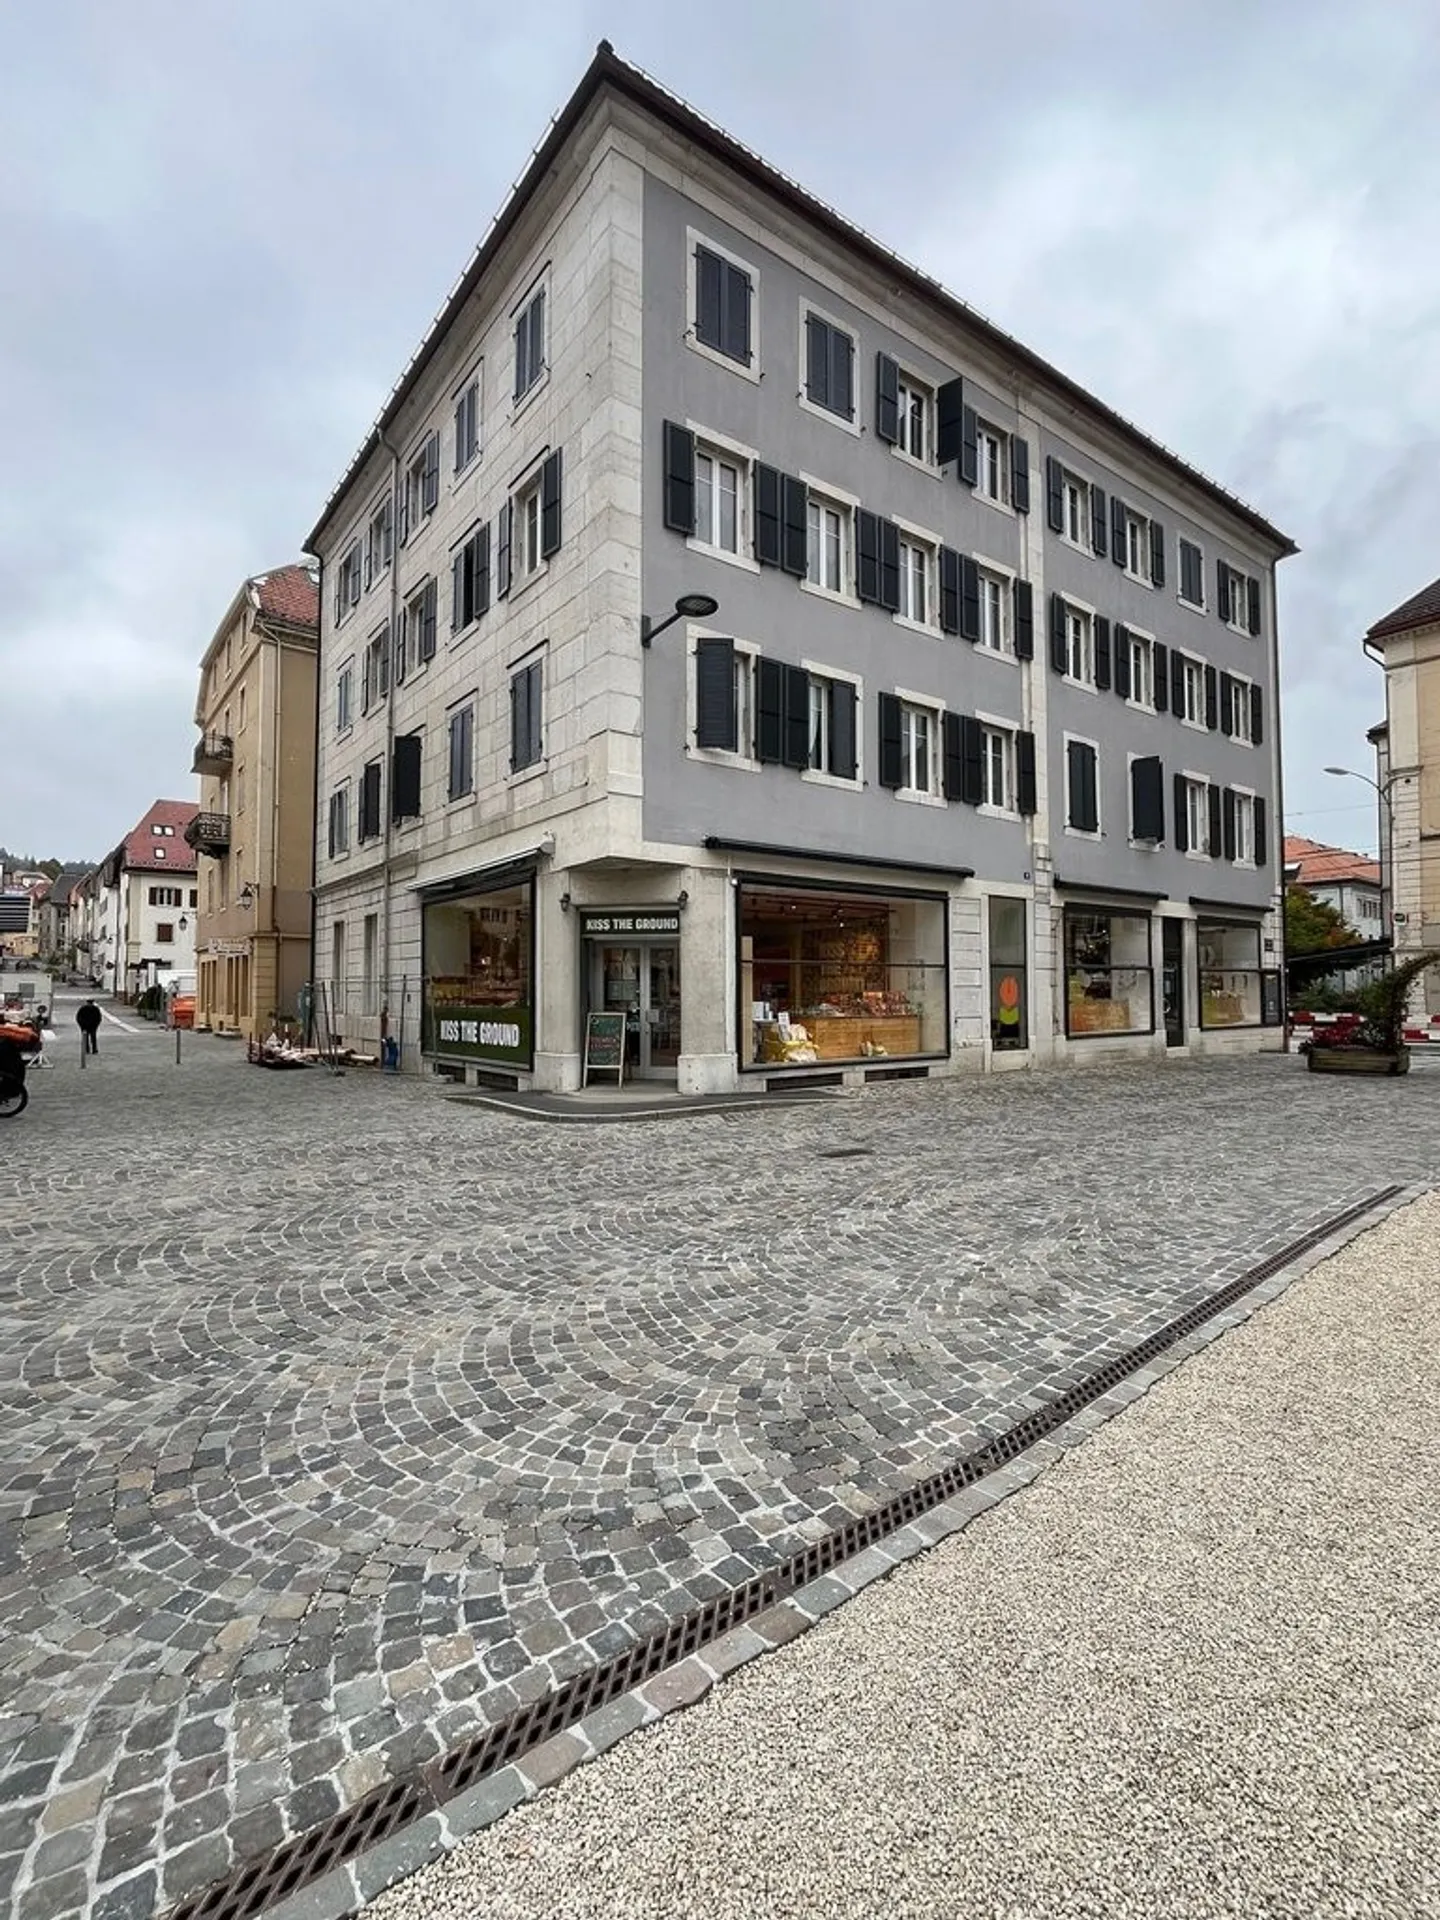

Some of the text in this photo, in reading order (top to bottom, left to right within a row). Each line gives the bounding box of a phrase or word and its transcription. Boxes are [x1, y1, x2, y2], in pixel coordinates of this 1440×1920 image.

[586, 918, 678, 931] KISS THE GROUND
[440, 1019, 520, 1048] KISS THE GROUND
